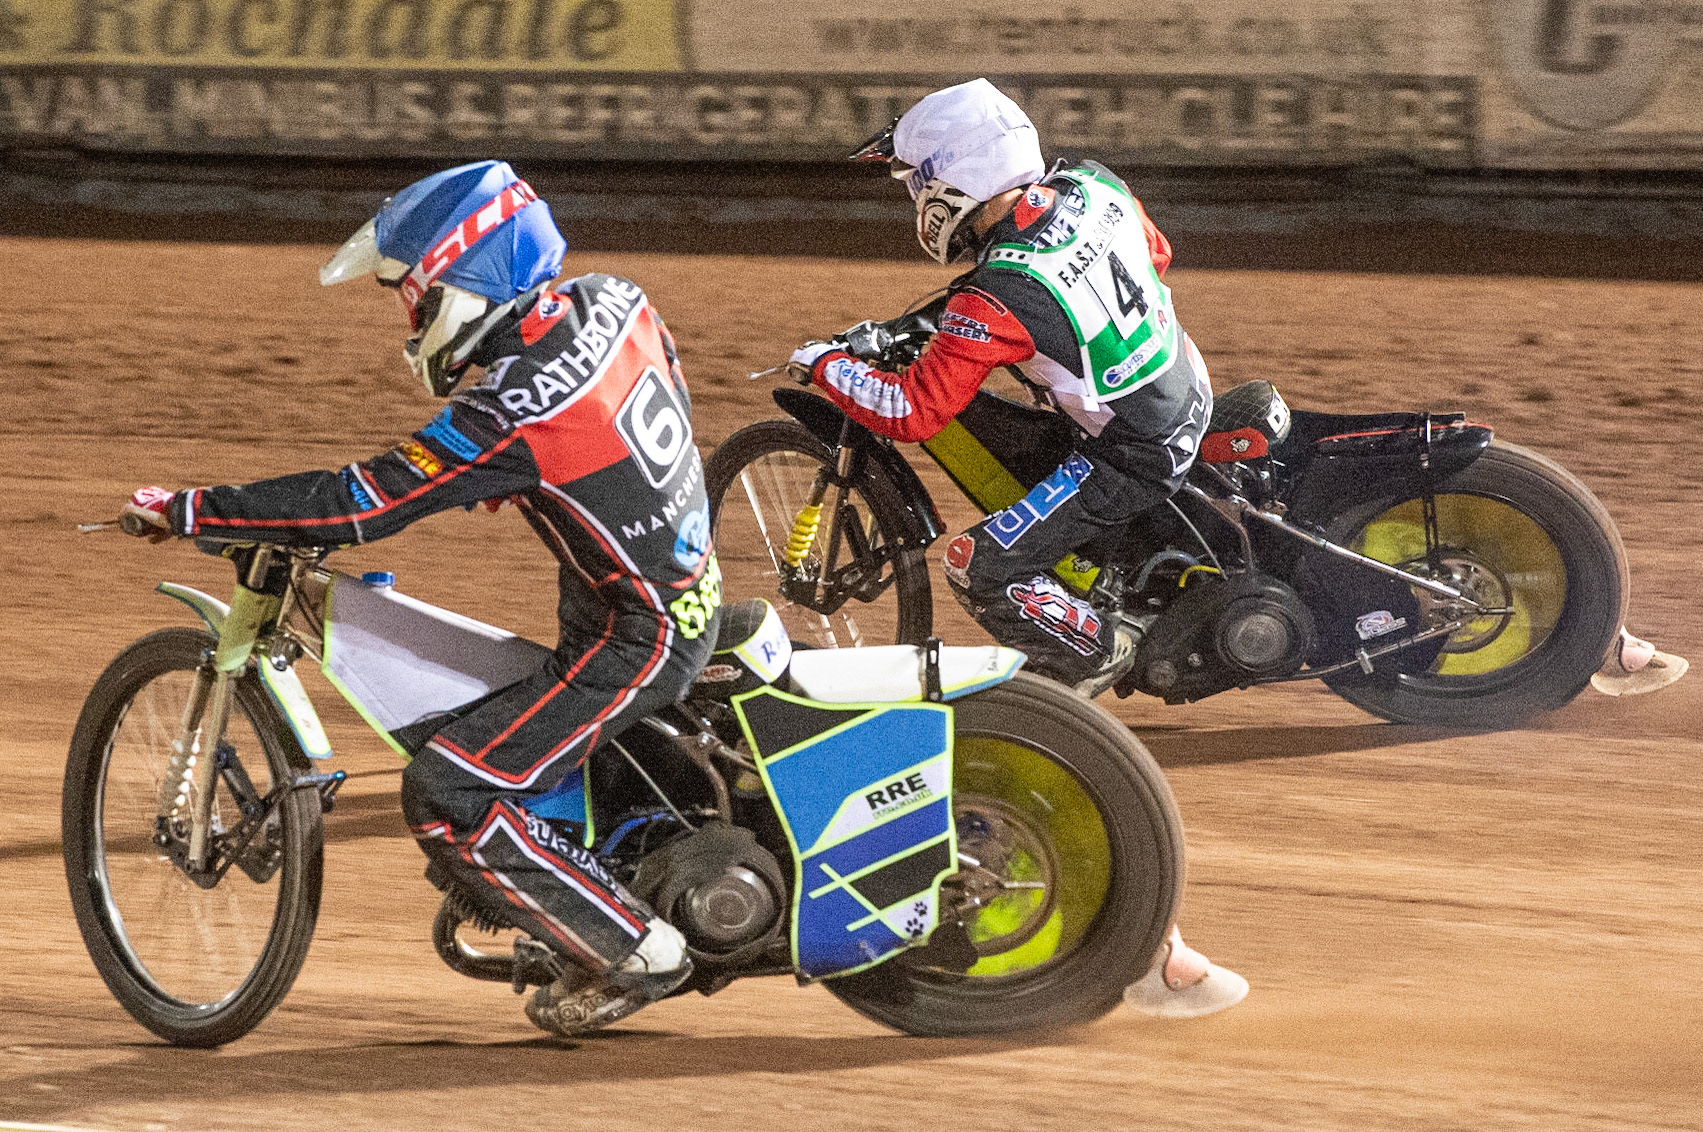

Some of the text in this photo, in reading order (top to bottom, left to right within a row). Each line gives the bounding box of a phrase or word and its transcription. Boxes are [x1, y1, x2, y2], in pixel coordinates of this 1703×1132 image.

[58, 0, 623, 59] Rochdale
[170, 79, 436, 142] MINIBUS
[446, 82, 494, 142] &
[1311, 88, 1464, 150] HIRE
[927, 212, 946, 245] BELL
[1107, 250, 1149, 319] 4
[498, 276, 642, 415] RATHBONE
[631, 379, 683, 466] 6
[865, 772, 927, 810] RRE
